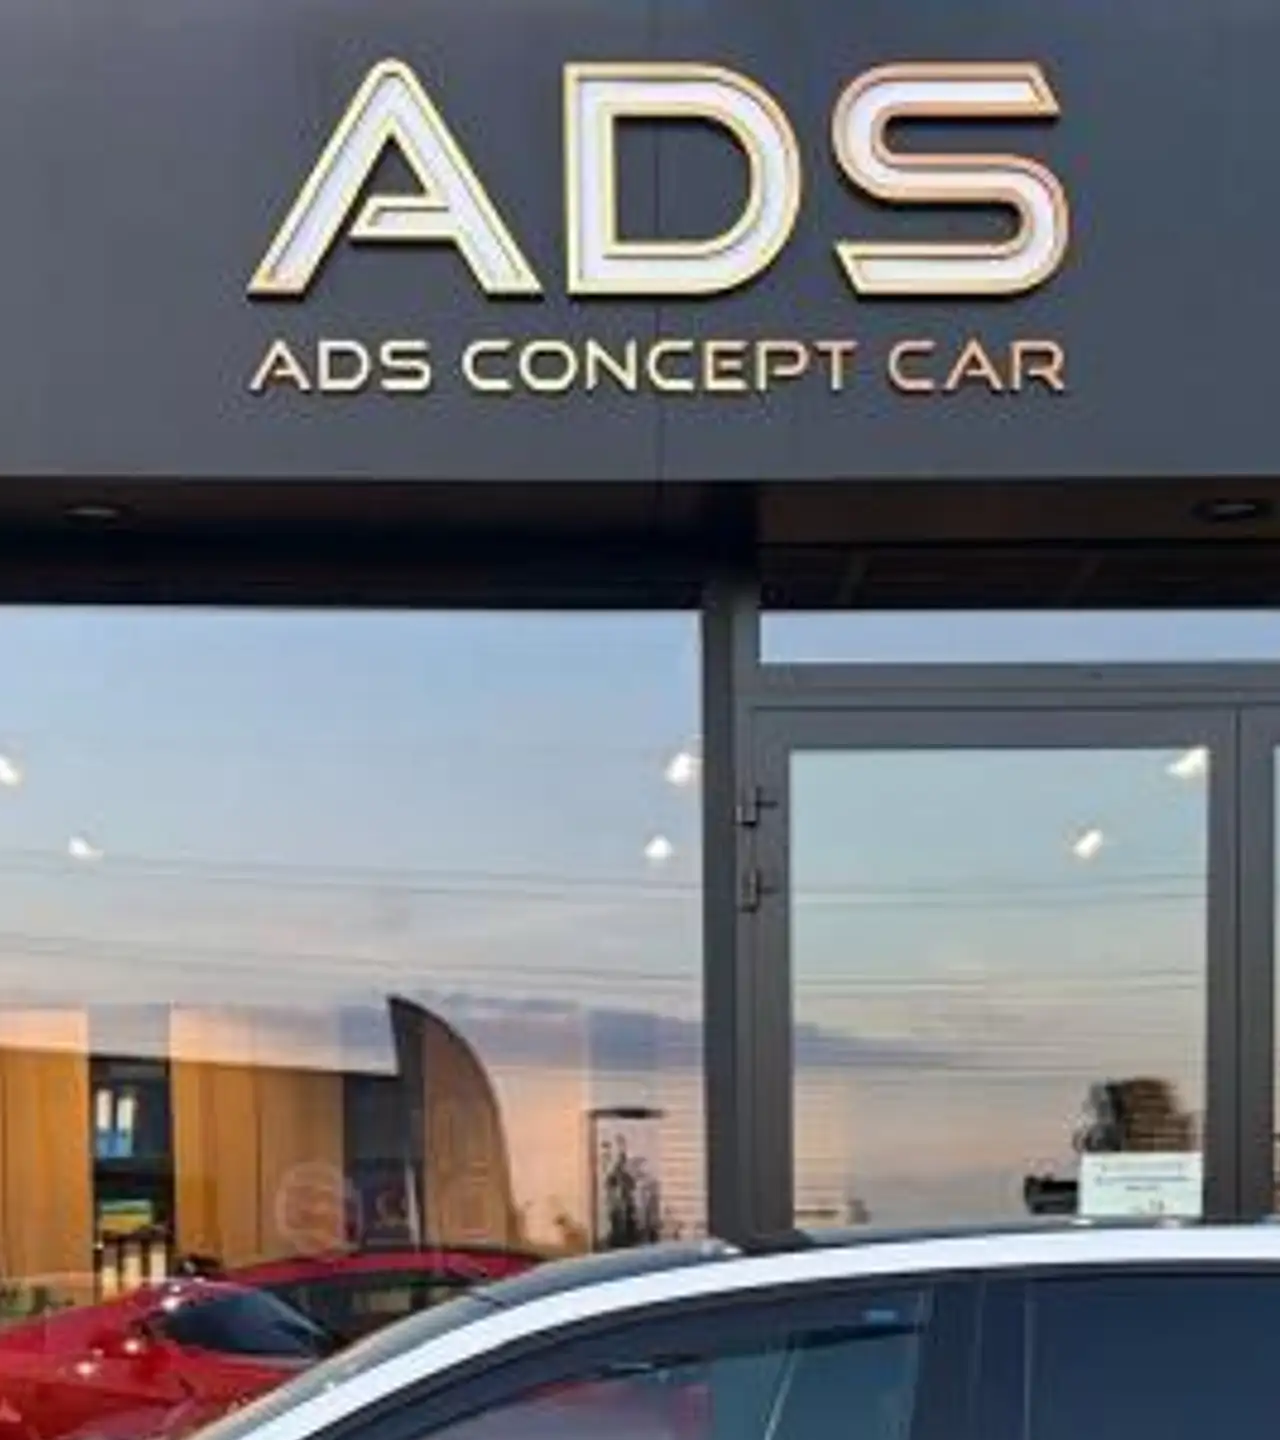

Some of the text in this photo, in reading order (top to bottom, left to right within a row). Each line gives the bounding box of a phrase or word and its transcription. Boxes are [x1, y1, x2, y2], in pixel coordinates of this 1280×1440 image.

[247, 57, 1070, 298] ADS
[250, 339, 1067, 394] ADS CONCEPT CAR
